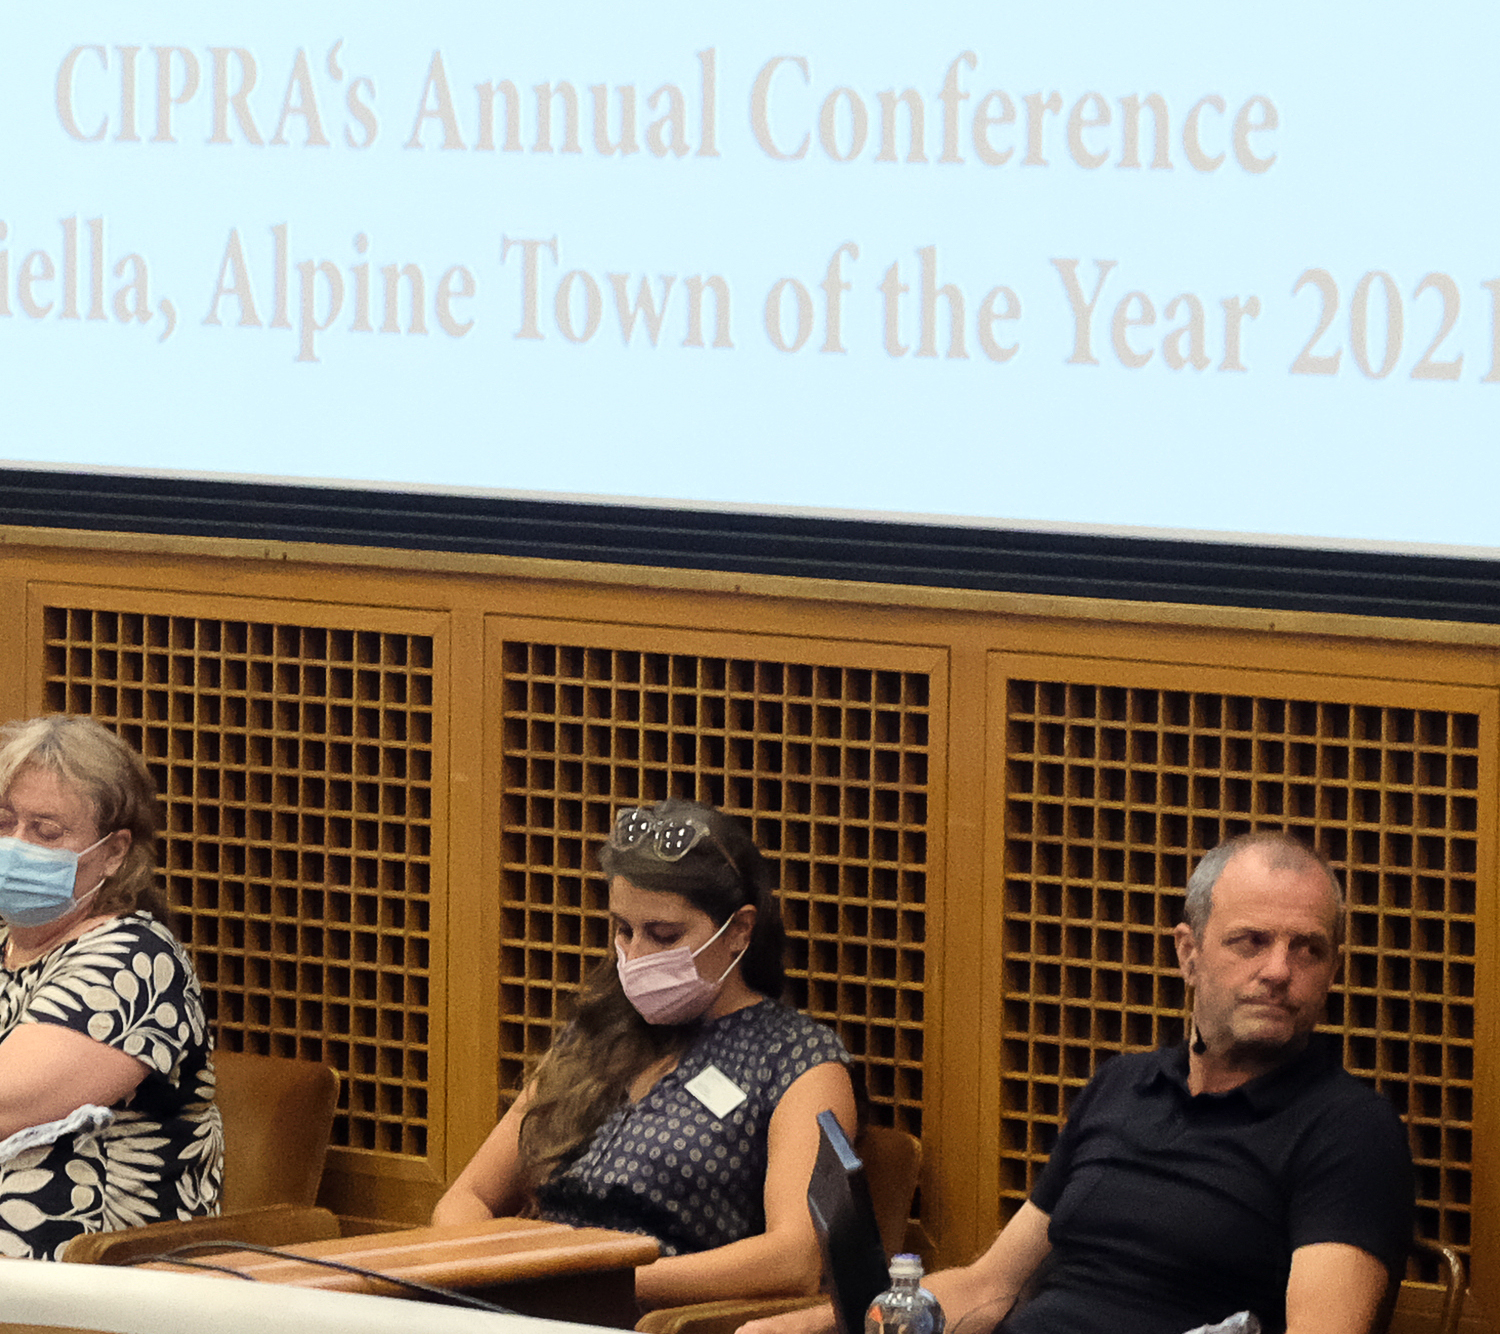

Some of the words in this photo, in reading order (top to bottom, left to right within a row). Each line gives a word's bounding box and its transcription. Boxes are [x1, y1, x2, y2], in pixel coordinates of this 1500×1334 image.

[403, 45, 722, 159] Annual
[748, 48, 1280, 175] Conference
[202, 221, 477, 364] Alpine
[500, 231, 736, 349] Town
[762, 240, 861, 354] of
[877, 243, 1022, 364] the
[1048, 256, 1261, 373] Year
